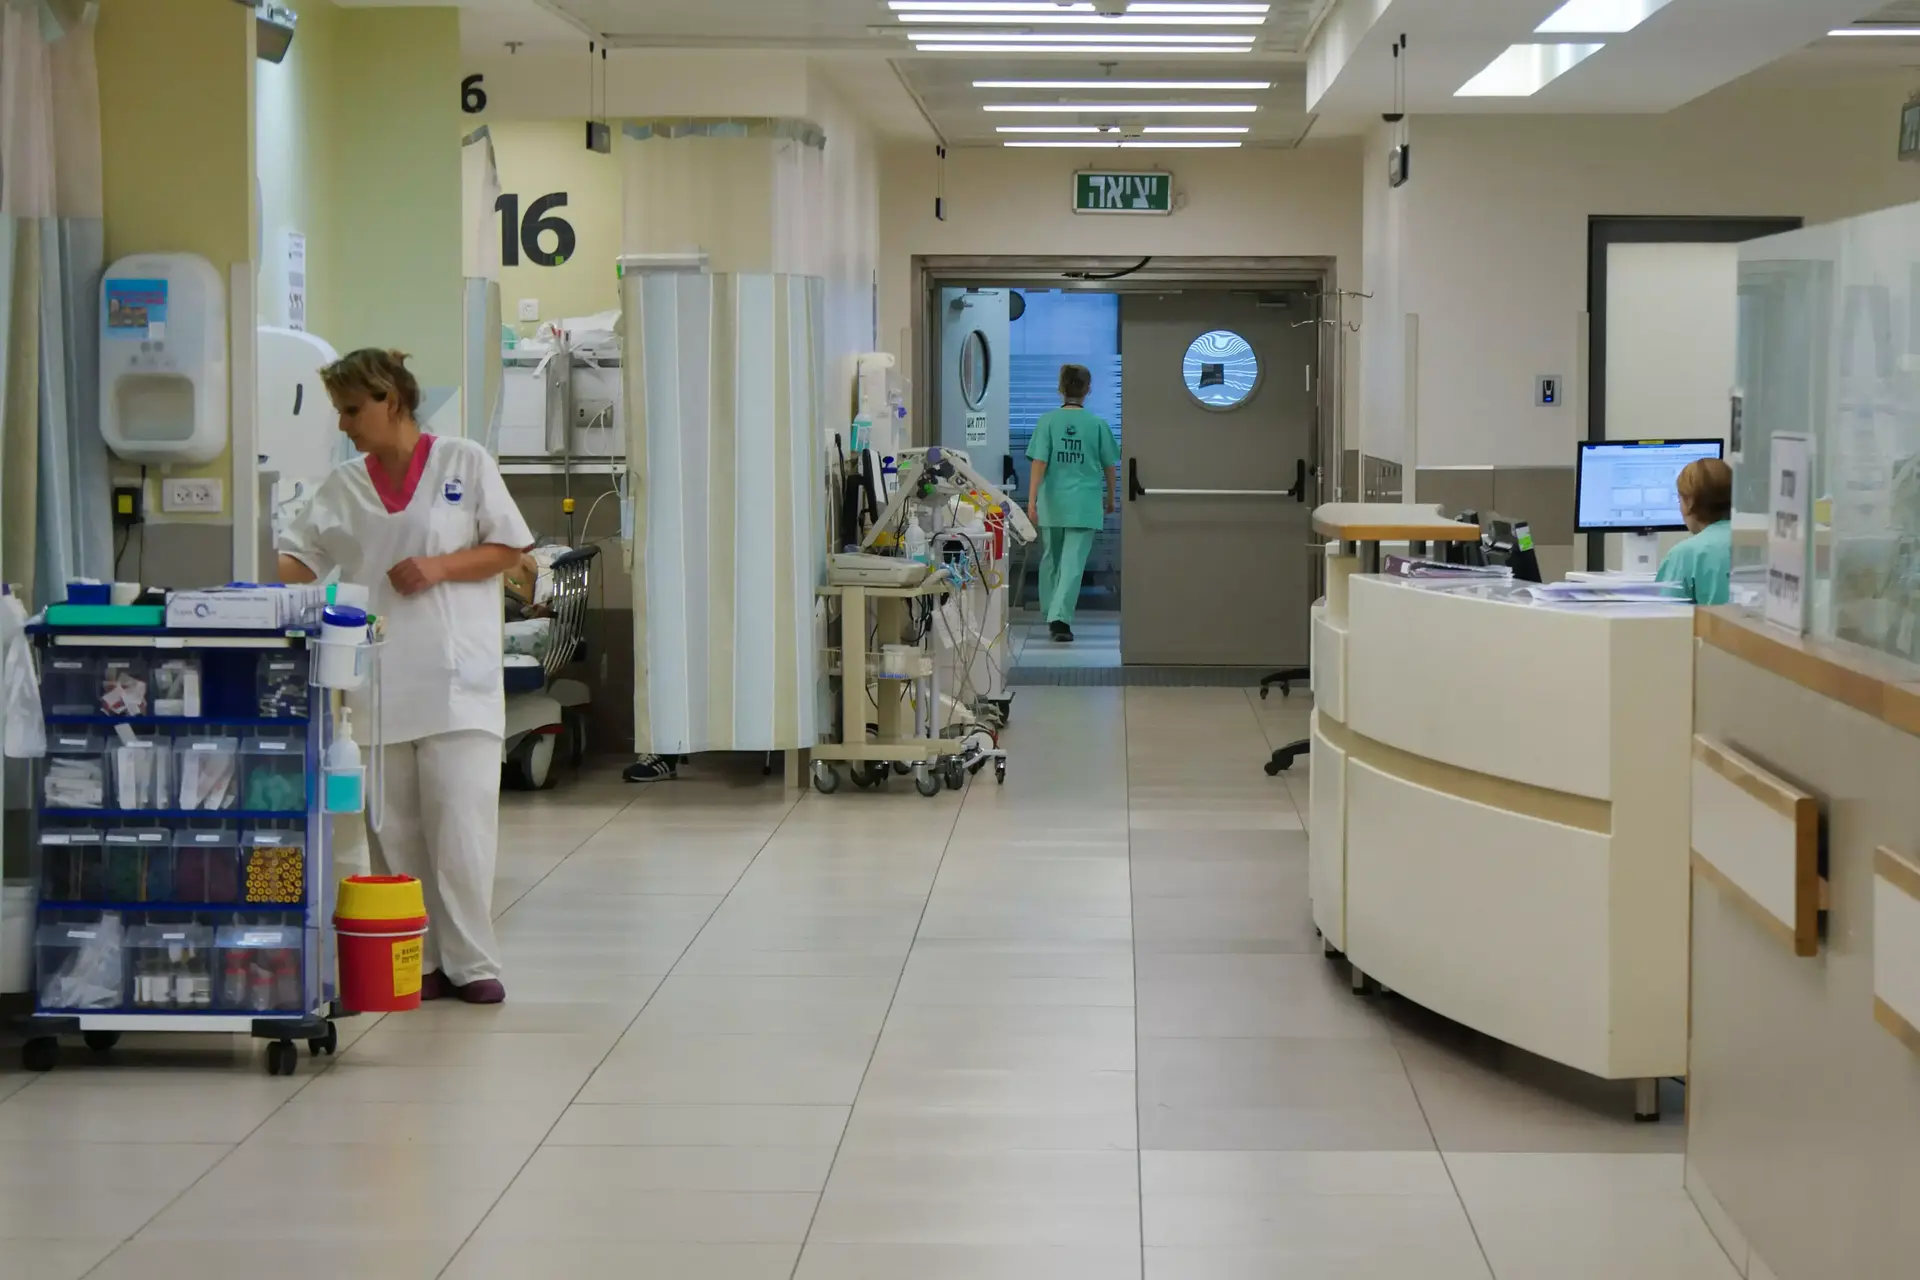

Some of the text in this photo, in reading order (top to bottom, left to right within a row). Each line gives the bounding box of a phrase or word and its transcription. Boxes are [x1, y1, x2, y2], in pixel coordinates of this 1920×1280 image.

[1088, 176, 1157, 208] יציאה
[494, 192, 576, 266] 16
[1061, 438, 1082, 450] חדר
[1057, 451, 1084, 464] ניתוח
